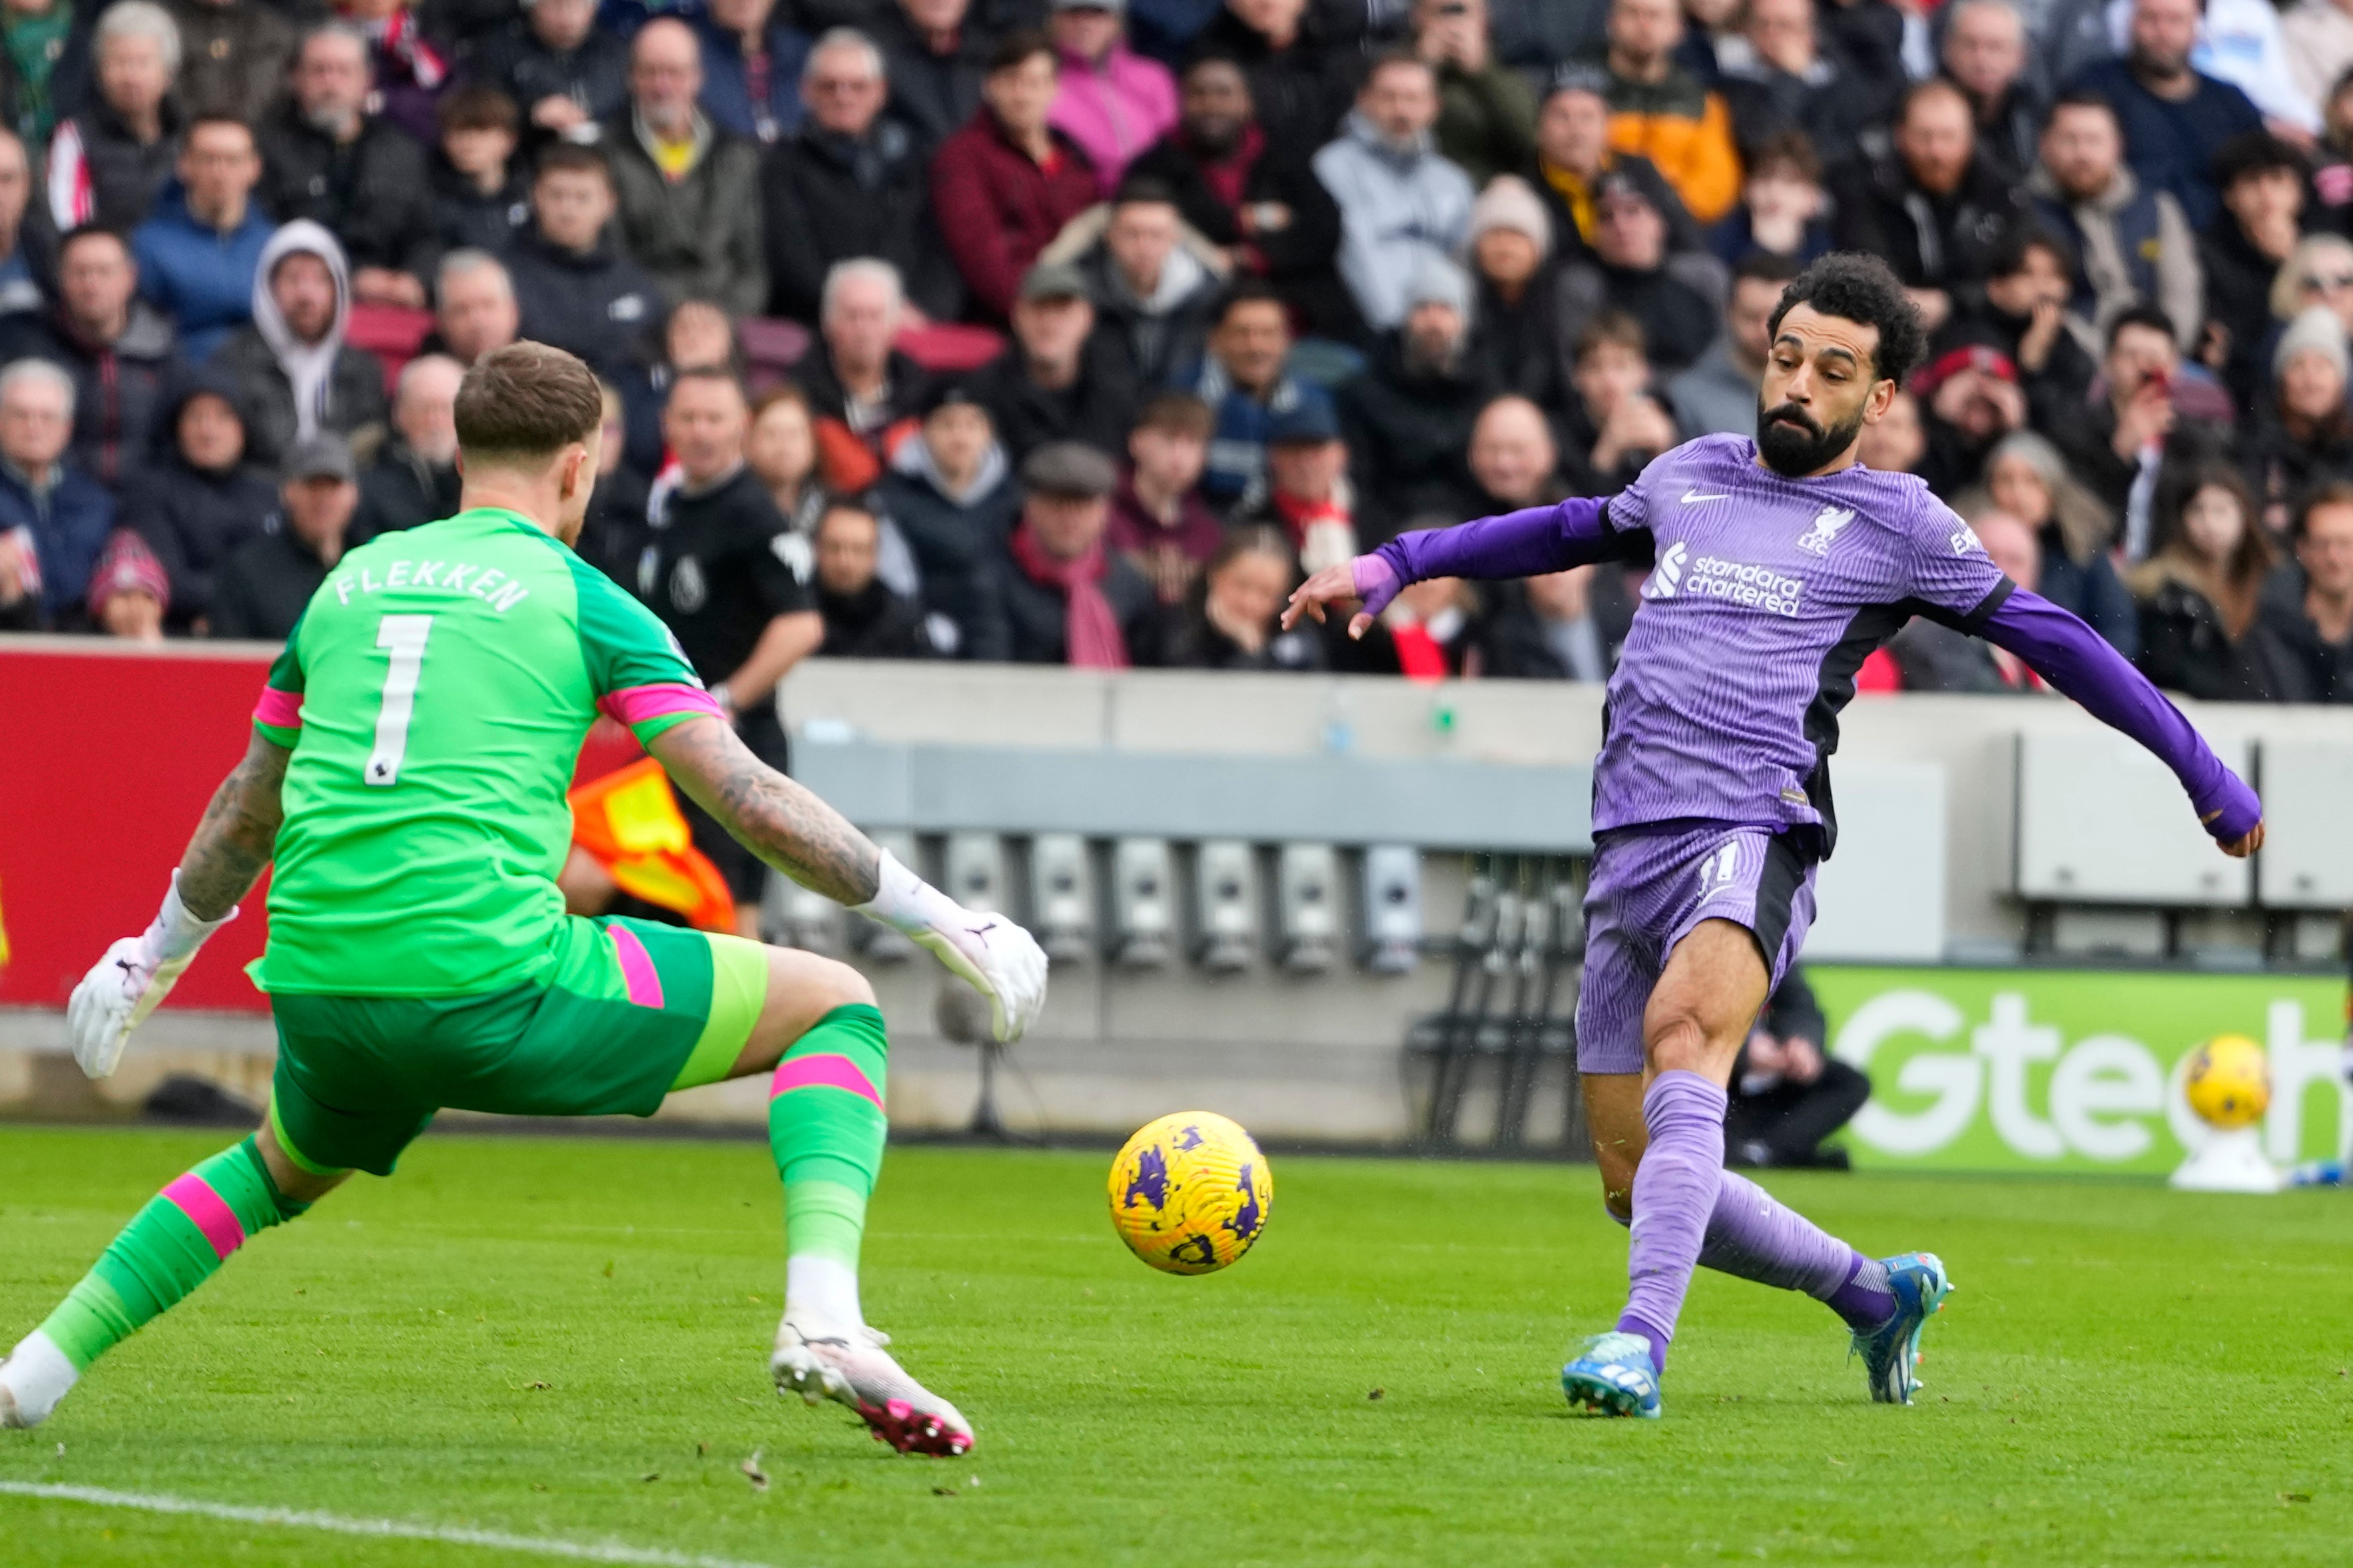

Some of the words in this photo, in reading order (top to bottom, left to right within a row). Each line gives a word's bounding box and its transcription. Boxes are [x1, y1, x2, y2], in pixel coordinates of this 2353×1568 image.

[335, 560, 529, 613] FLEKKEN
[1686, 575, 1800, 617] chartered
[1693, 556, 1802, 599] standard
[364, 615, 434, 785] 1
